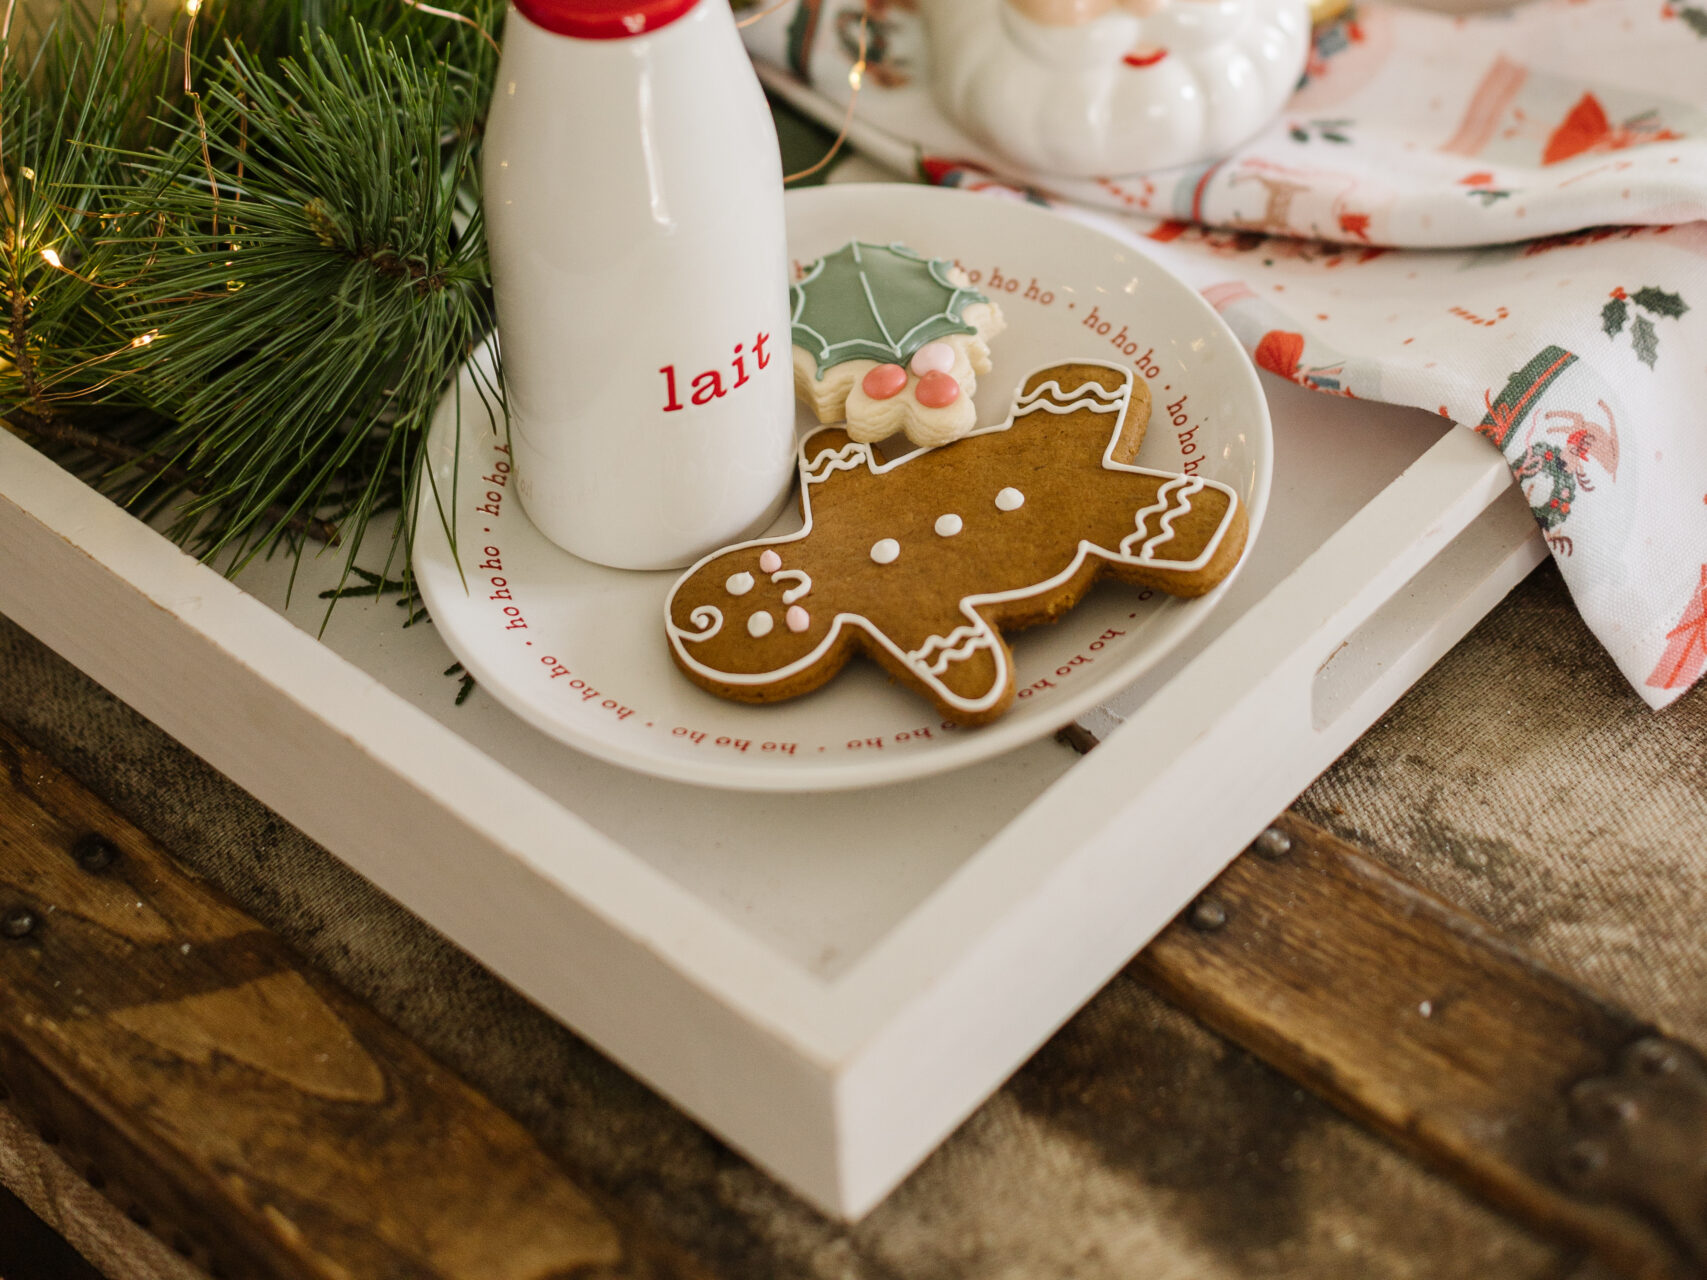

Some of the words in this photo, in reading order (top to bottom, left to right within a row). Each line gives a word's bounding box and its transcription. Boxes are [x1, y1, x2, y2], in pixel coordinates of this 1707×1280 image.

[988, 267, 1020, 293] ho
[1024, 277, 1055, 305] ho
[1082, 306, 1112, 336] ho
[1110, 325, 1138, 356] ho
[1134, 348, 1161, 379] ho
[659, 331, 770, 412] lait
[1166, 395, 1188, 427] ho
[1178, 425, 1200, 455] ho
[482, 461, 511, 487] ho
[1184, 455, 1206, 477] h
[476, 491, 502, 517] ho
[479, 546, 503, 571] ho
[489, 577, 512, 601] ho
[503, 606, 528, 631] ho
[1089, 628, 1126, 651] ho
[541, 655, 571, 678] ho
[1055, 655, 1094, 676] ho
[569, 679, 601, 701] ho
[1018, 678, 1056, 698] ho
[601, 699, 635, 720] ho
[672, 726, 708, 744] ho
[715, 736, 752, 752] ho
[847, 737, 883, 750] ho
[895, 727, 933, 742] ho
[761, 741, 798, 755] ho
